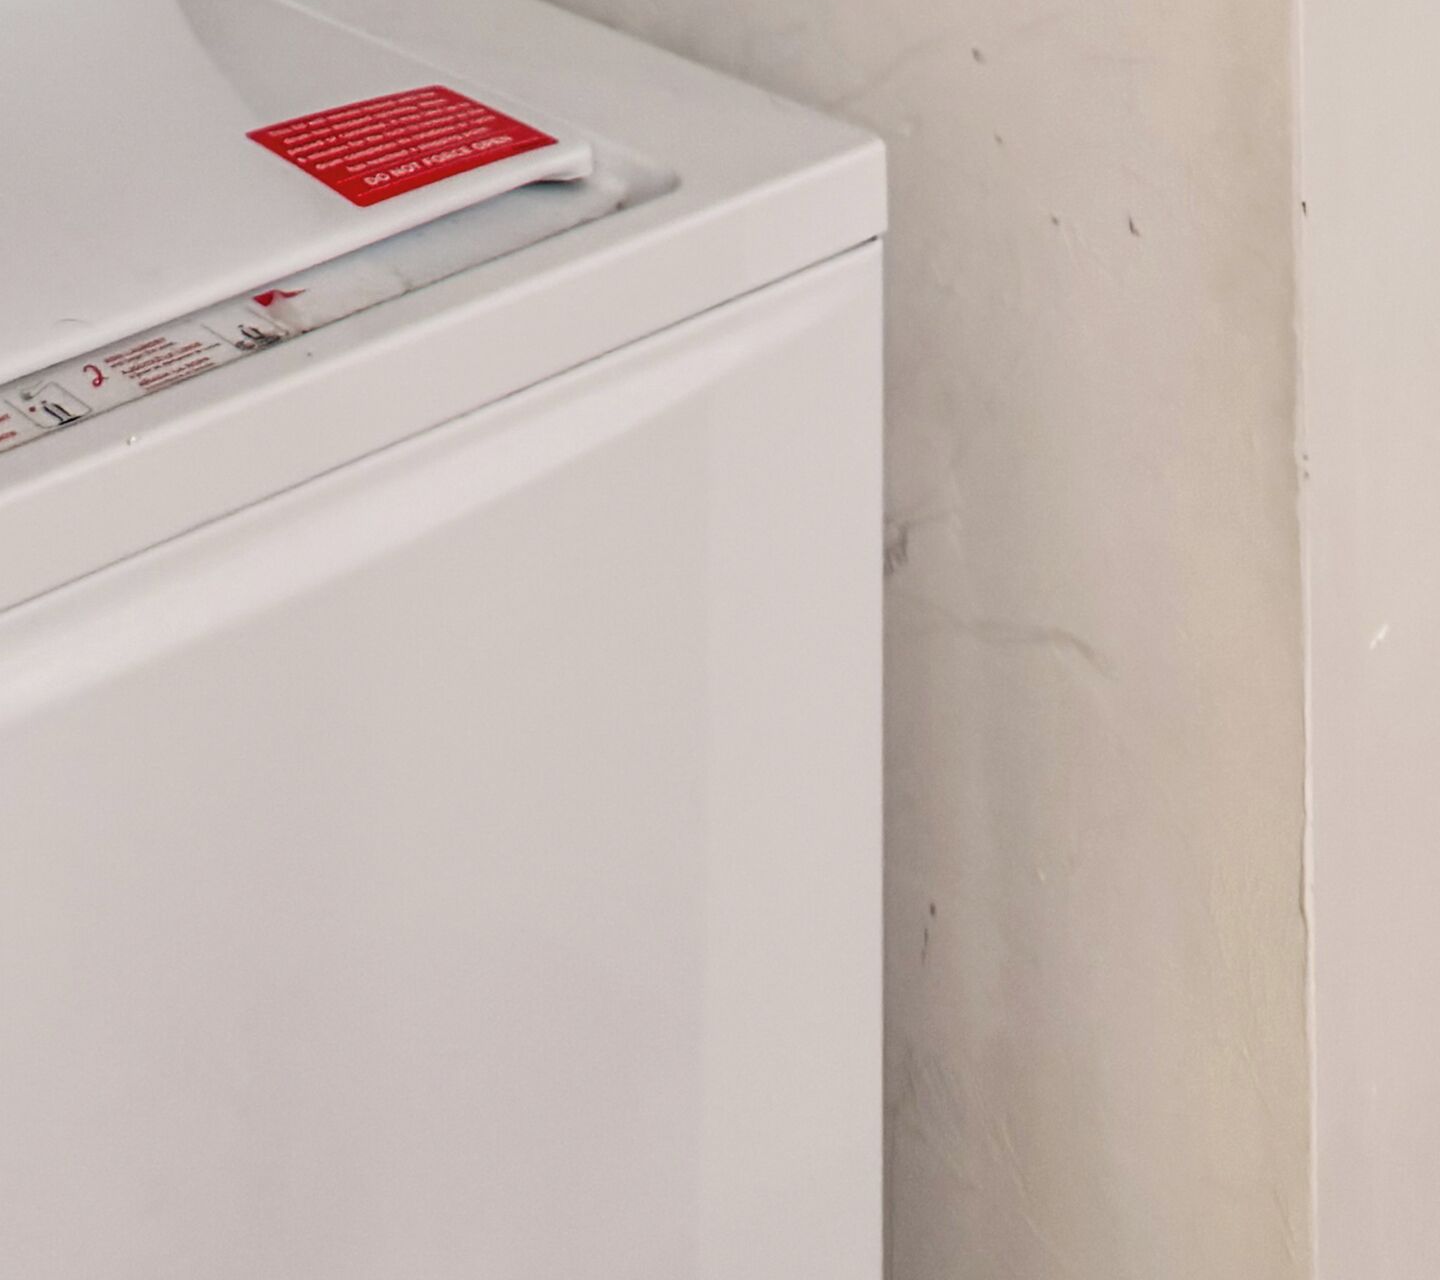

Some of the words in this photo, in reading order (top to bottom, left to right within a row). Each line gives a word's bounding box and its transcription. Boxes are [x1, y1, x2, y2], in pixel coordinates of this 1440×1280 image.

[364, 173, 391, 187] DO
[390, 163, 417, 178] NOT
[82, 364, 103, 387] 2
